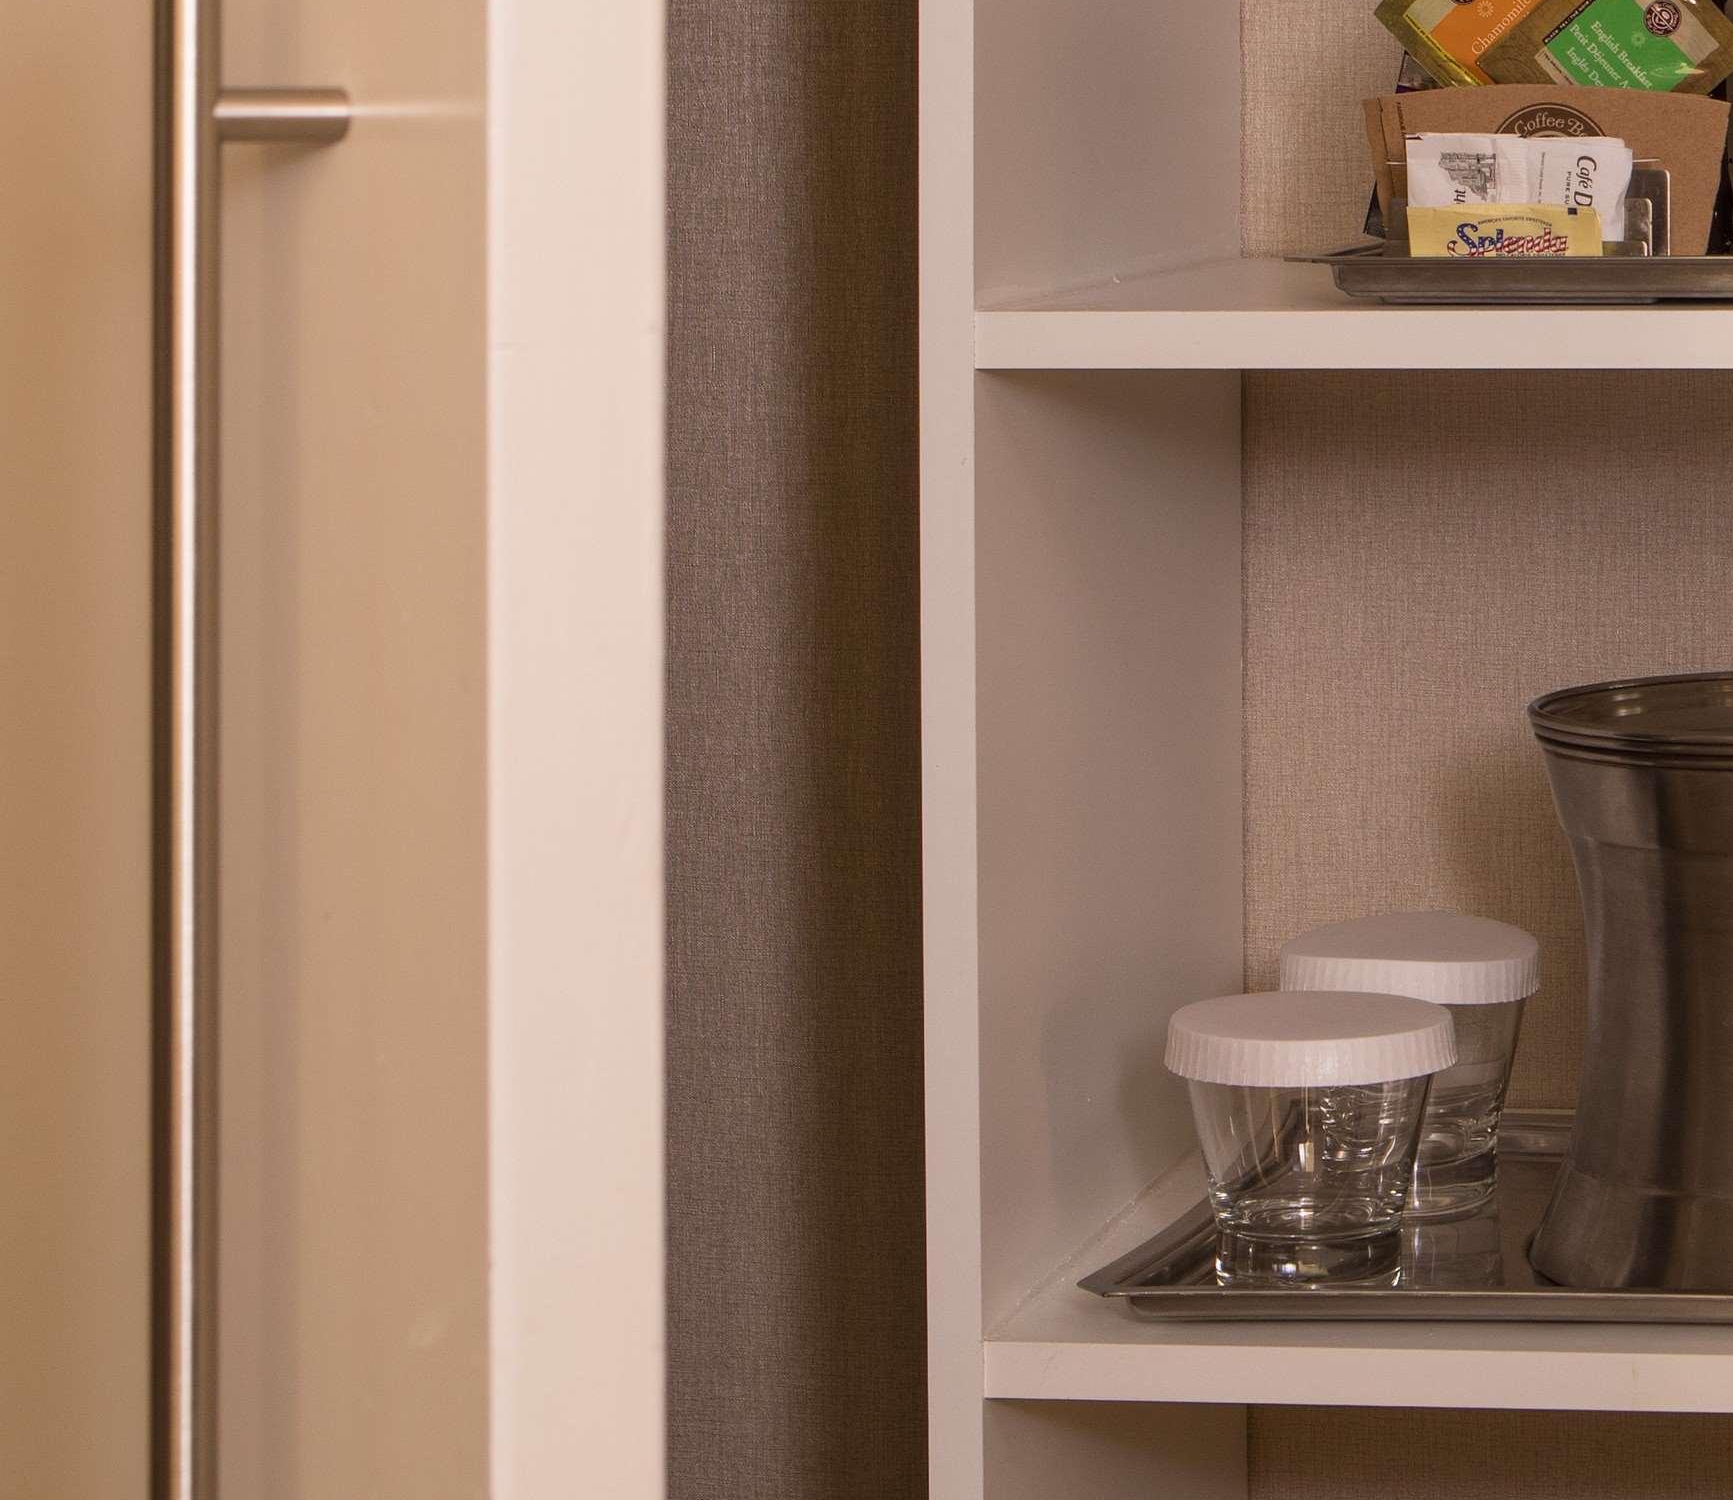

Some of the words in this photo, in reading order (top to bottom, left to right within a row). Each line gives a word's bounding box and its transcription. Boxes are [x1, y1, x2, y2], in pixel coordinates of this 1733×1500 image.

[1590, 20, 1619, 55] English
[1514, 113, 1564, 136] Coffee
[1577, 156, 1596, 188] Café
[1447, 223, 1568, 257] Splenda
